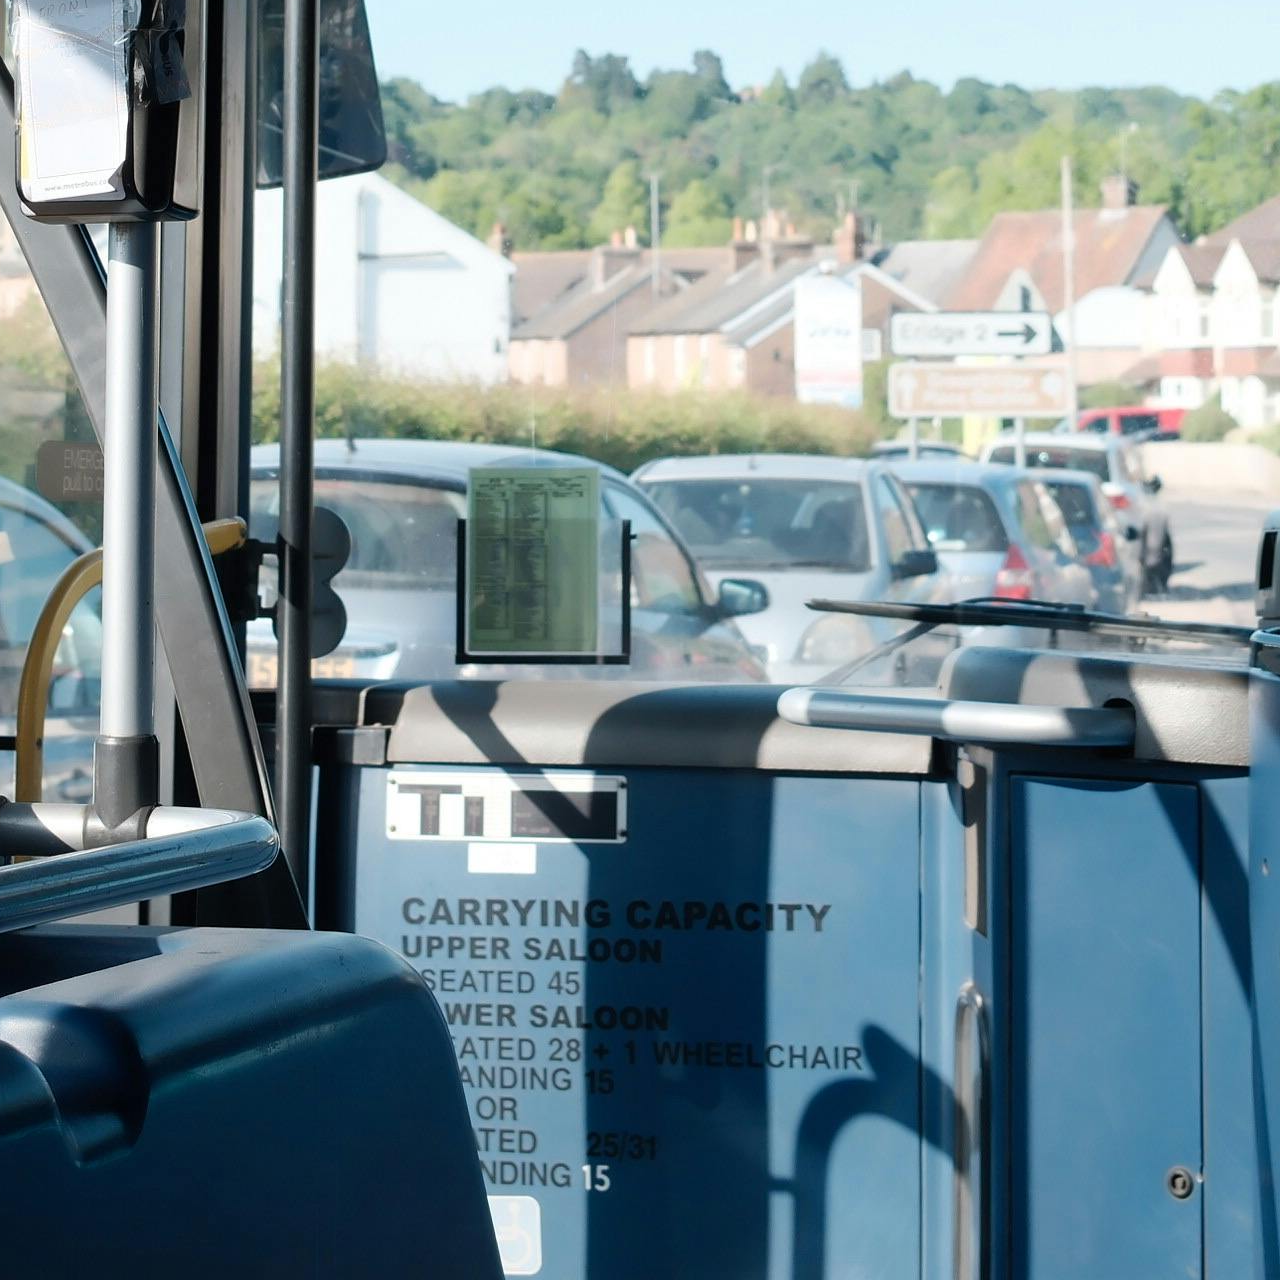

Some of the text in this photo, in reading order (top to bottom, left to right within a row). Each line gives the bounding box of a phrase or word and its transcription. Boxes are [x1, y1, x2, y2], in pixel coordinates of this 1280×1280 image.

[402, 897, 832, 933] CARRYING CAPACITY
[401, 934, 663, 964] UPPER SALOON
[421, 968, 581, 996] SEATED 45
[444, 1002, 669, 1031] WER SALOON
[454, 1036, 864, 1071] ATED 28 + 1 WHEELCHAIR
[460, 1066, 615, 1094] ANDING 15
[475, 1095, 518, 1121] OR
[475, 1127, 659, 1162] TED 25/31
[479, 1160, 612, 1192] NDING 15
